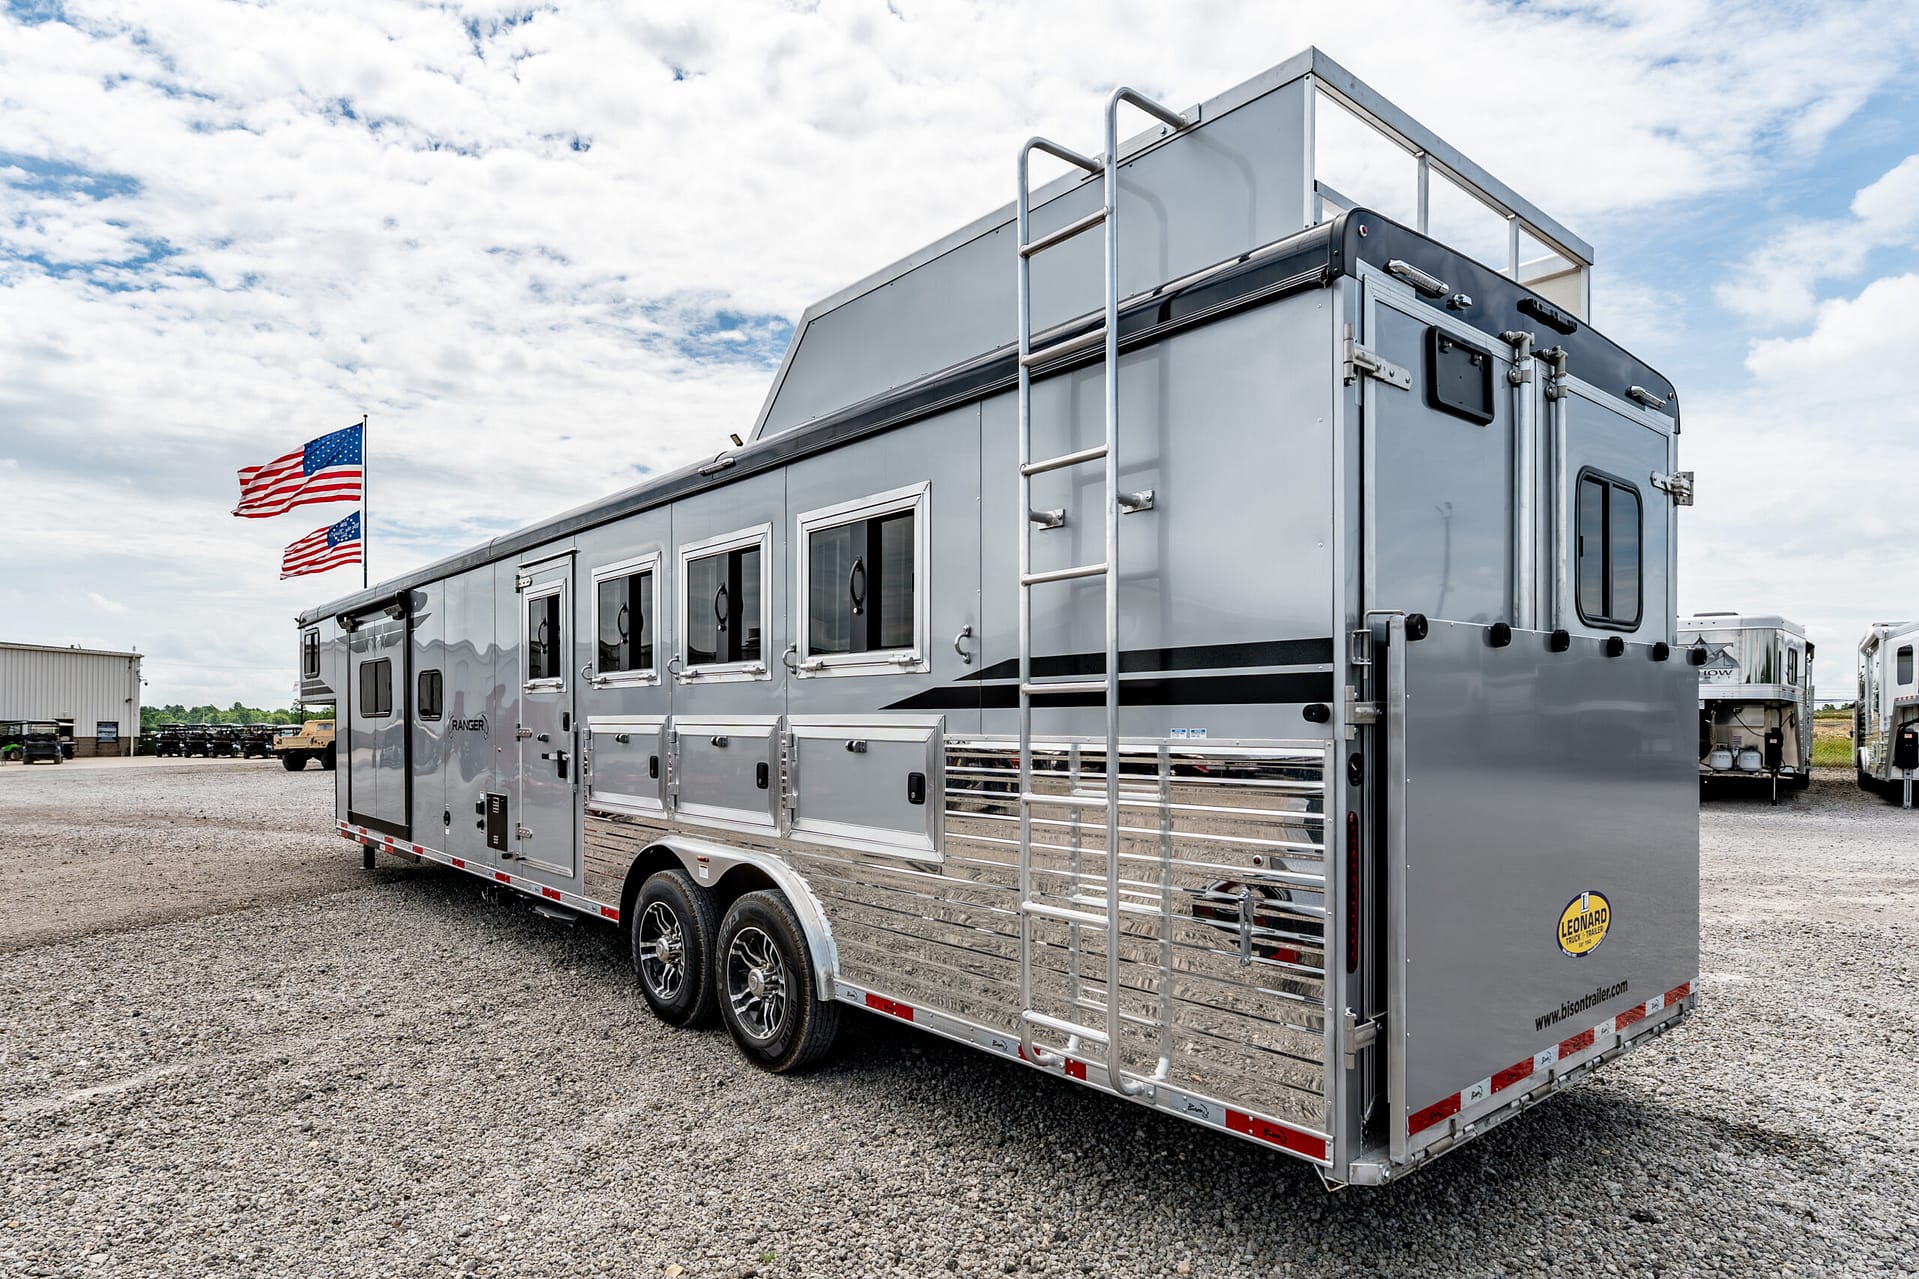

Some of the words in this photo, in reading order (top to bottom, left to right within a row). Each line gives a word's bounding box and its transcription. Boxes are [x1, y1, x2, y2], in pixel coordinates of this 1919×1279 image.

[452, 719, 484, 731] RANGER
[1562, 907, 1607, 938] LEONARD
[1535, 980, 1628, 1032] www.bisontrailer.com
